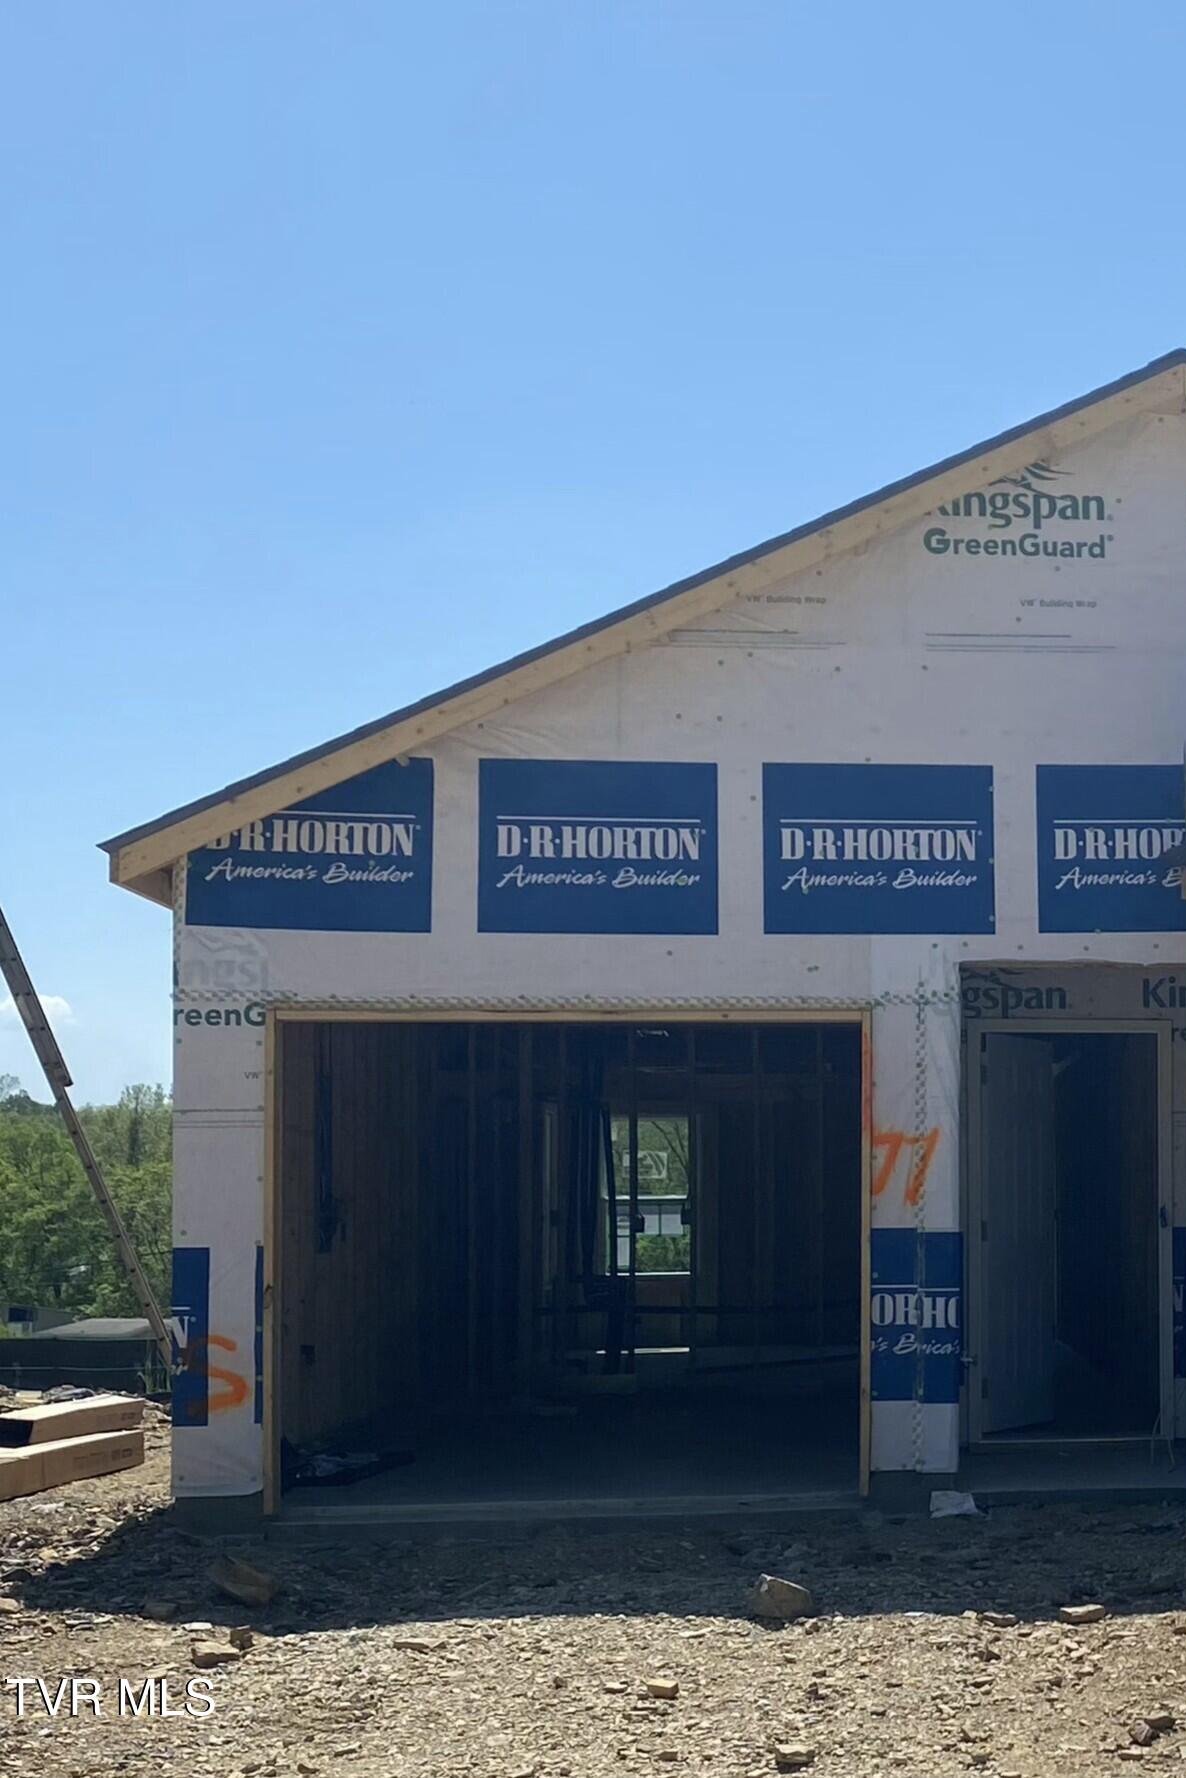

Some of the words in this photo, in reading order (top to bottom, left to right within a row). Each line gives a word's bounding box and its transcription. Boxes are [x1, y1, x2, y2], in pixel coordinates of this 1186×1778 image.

[924, 487, 1106, 530] ingspan
[923, 528, 1106, 559] GreenGuard
[205, 857, 318, 882] America's
[322, 862, 415, 885] Builder
[496, 865, 607, 889] America's
[612, 868, 701, 889] Builder
[781, 865, 888, 891] America's
[892, 866, 978, 890] Builder
[1055, 866, 1158, 891] America's
